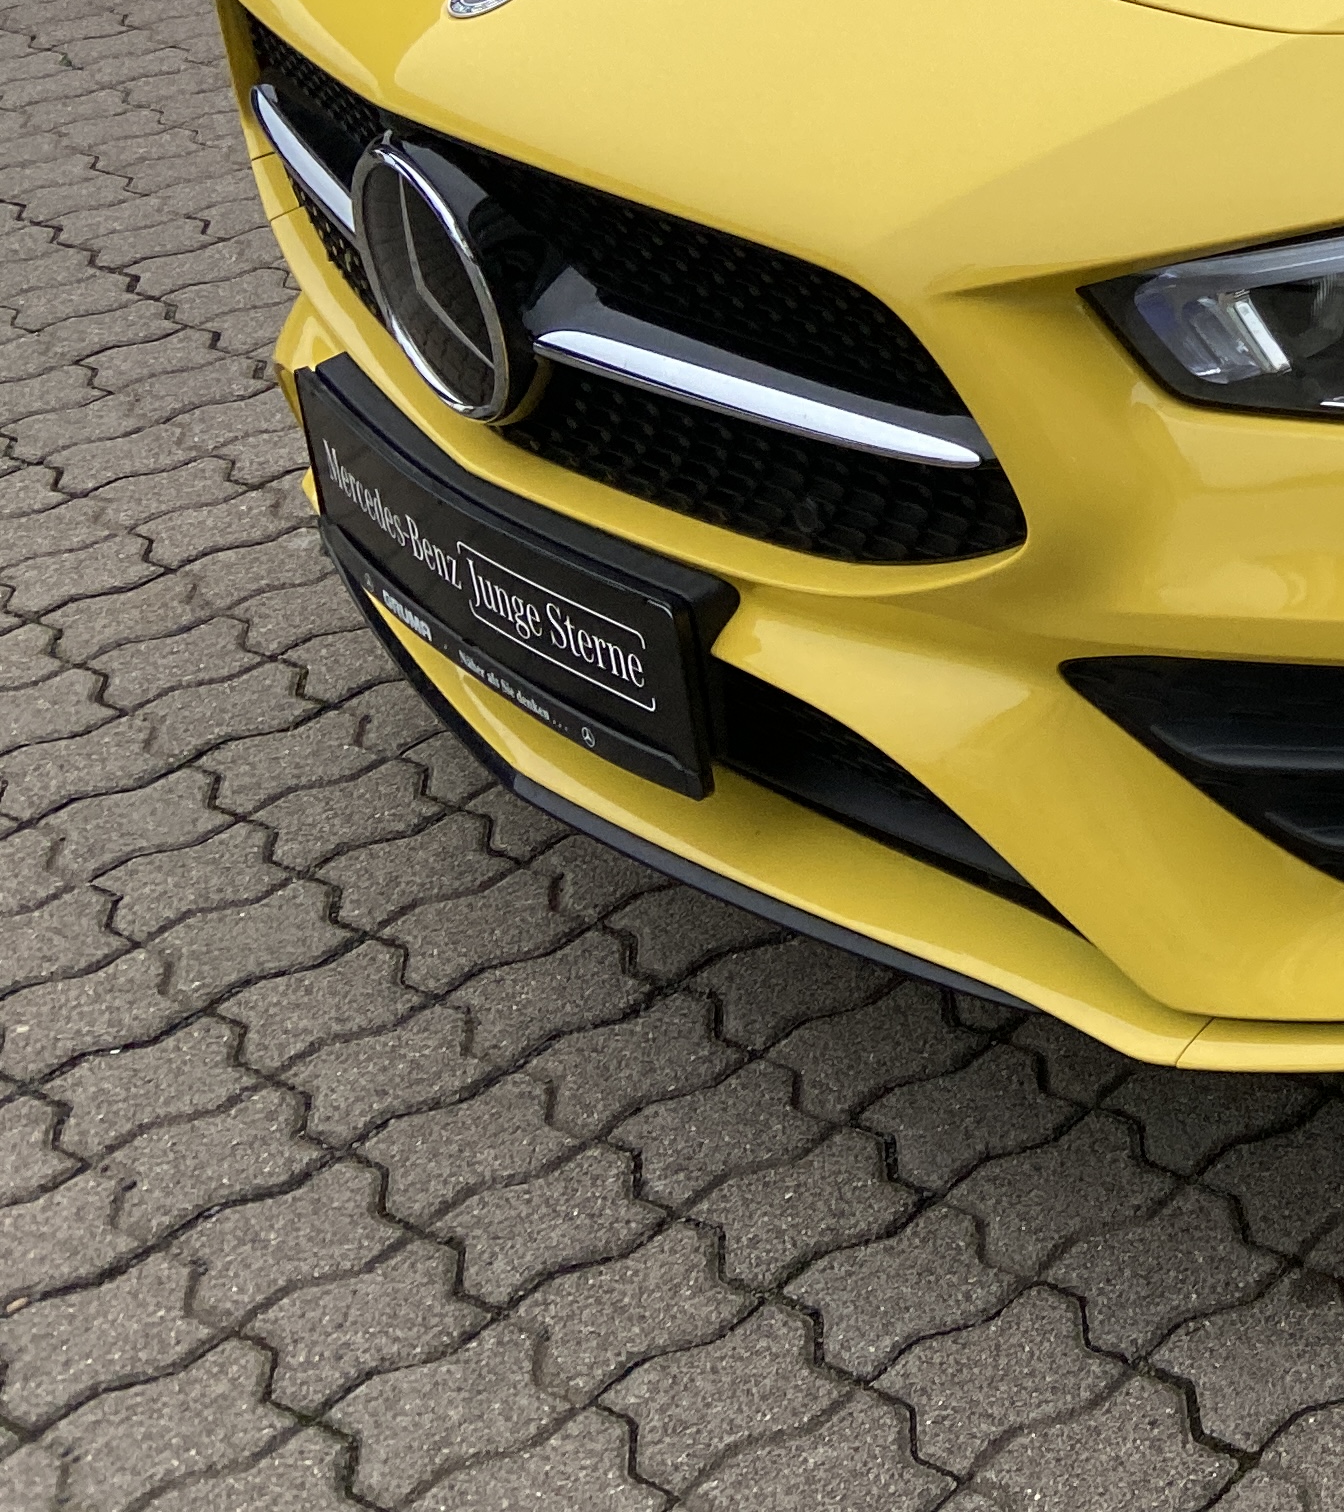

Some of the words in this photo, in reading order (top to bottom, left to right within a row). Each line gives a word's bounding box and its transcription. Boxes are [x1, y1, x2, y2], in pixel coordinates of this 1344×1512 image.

[322, 438, 462, 590] Mercedes-Benz
[467, 557, 543, 640] Junge
[546, 603, 646, 688] Sterne
